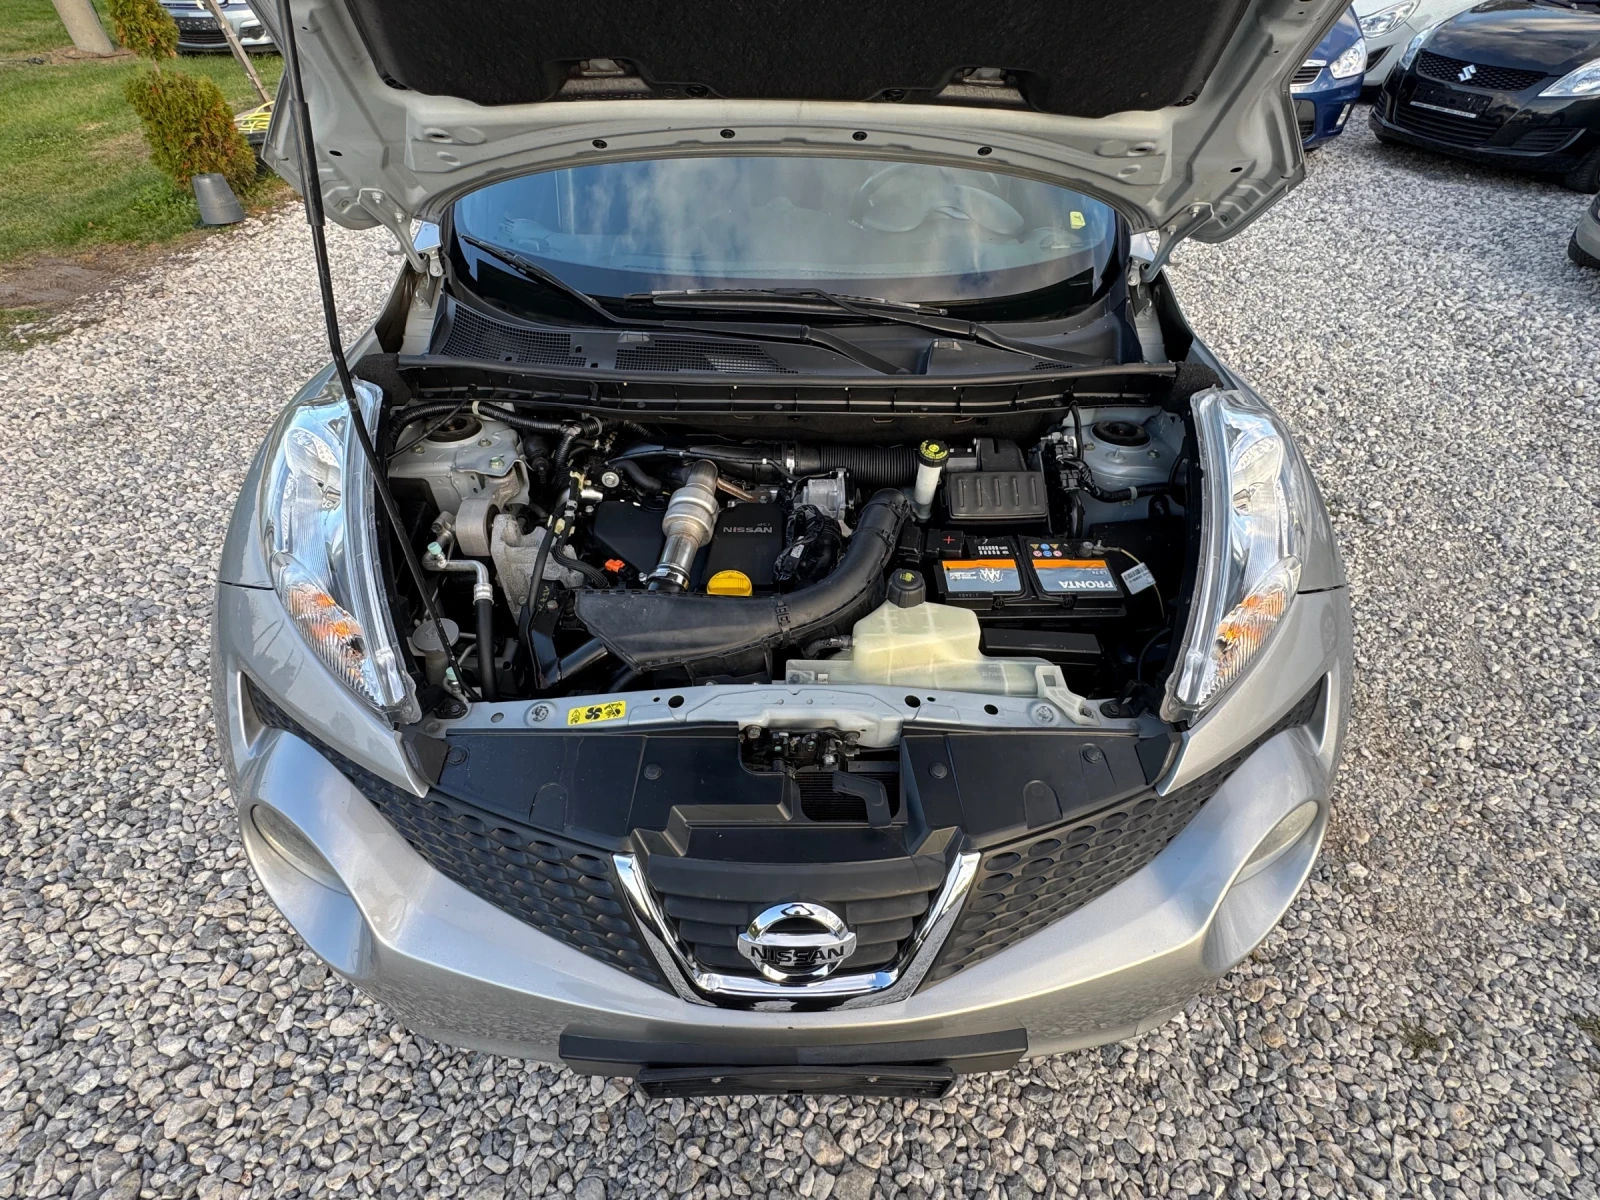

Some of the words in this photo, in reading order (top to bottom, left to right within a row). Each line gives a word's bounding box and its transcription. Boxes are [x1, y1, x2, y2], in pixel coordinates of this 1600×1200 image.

[722, 526, 773, 534] NISSAN
[1057, 580, 1114, 589] PRONTA
[750, 945, 845, 963] NISSAN
